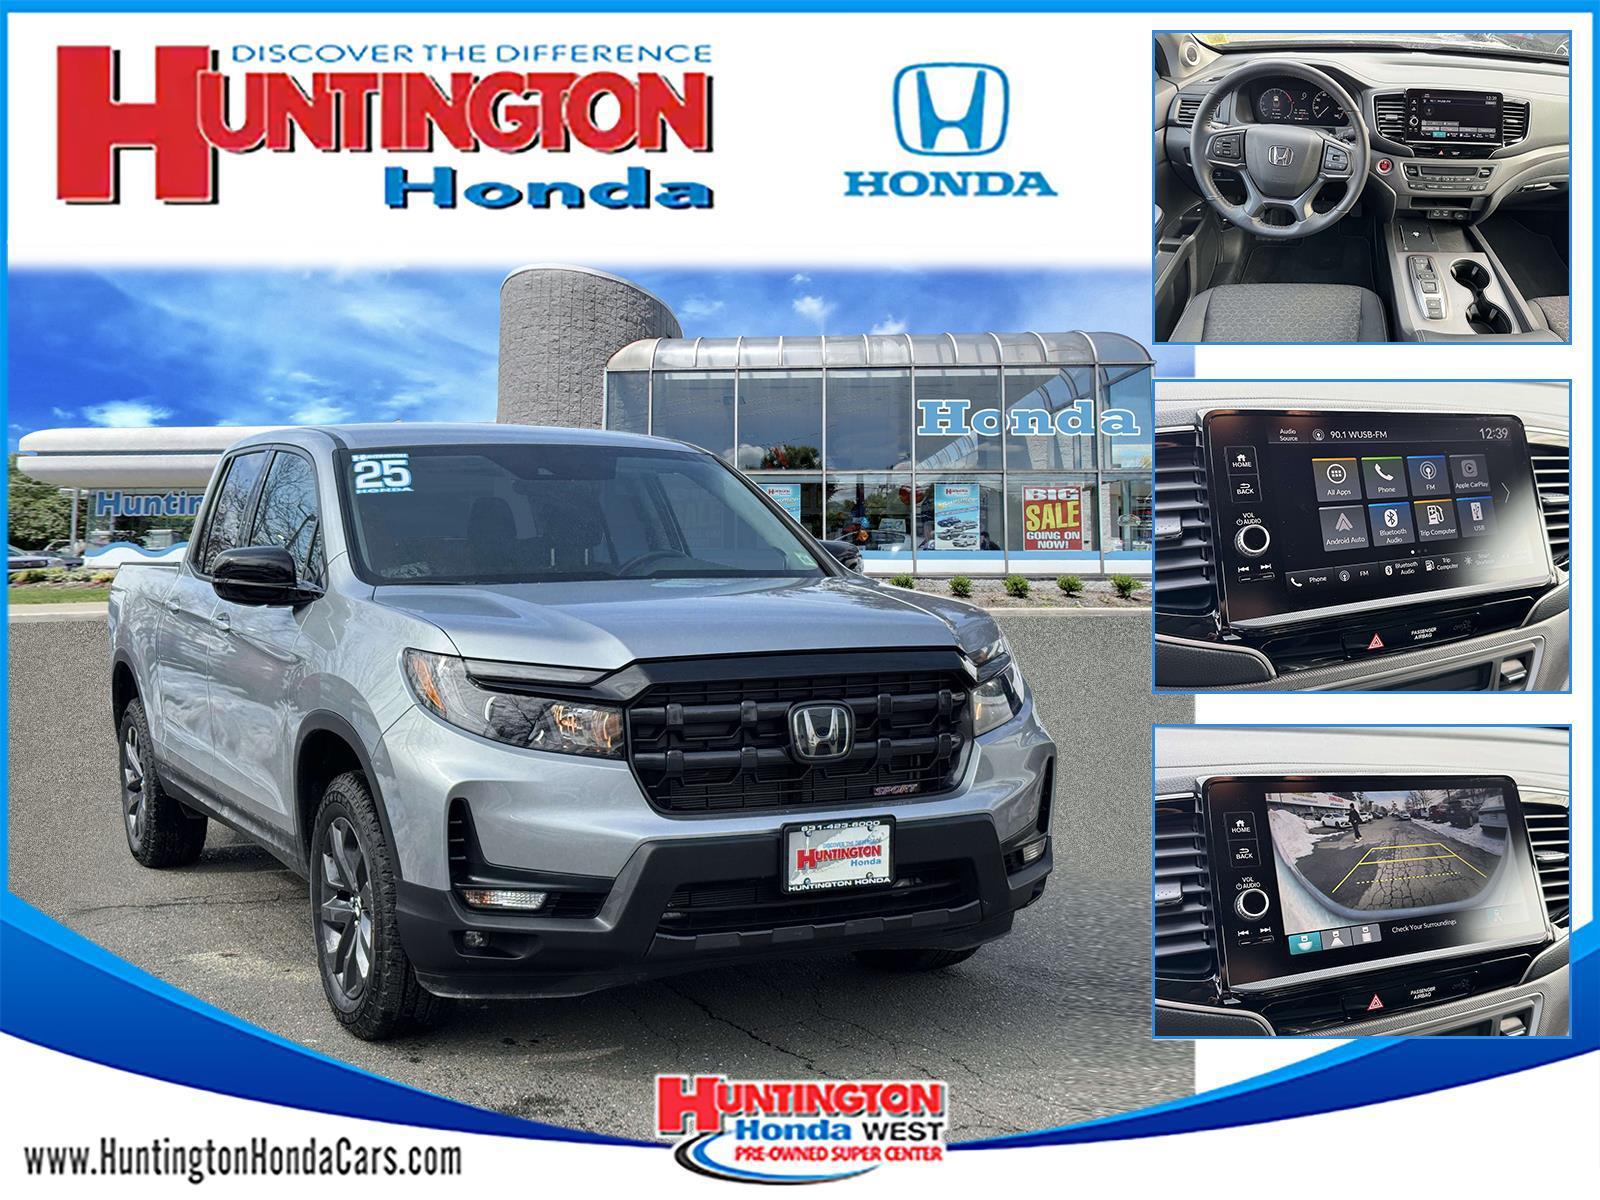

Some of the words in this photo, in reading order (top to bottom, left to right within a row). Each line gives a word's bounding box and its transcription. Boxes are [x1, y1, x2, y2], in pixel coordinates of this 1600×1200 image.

[917, 399, 1141, 436] Honda
[1279, 426, 1297, 435] Audio
[1330, 430, 1346, 439] 90.1
[1348, 430, 1388, 439] WUSB-FM
[1479, 427, 1509, 440] 12:39
[354, 460, 412, 489] 25
[1025, 488, 1080, 501] BIG
[1025, 500, 1080, 532] SALE
[1243, 517, 1262, 525] AUDIO
[1026, 531, 1061, 540] GOING
[1064, 531, 1080, 540] ON
[1379, 528, 1407, 537] Bluetooth
[1430, 528, 1456, 536] Computer
[1038, 540, 1069, 549] NOW!
[1326, 538, 1350, 546] Android
[851, 859, 882, 867] Honda
[788, 880, 852, 892] HUNTINGTON
[854, 877, 891, 886] HONDA
[1391, 925, 1410, 933] Check
[1409, 923, 1423, 931] Your
[1423, 919, 1457, 929] Surroundings
